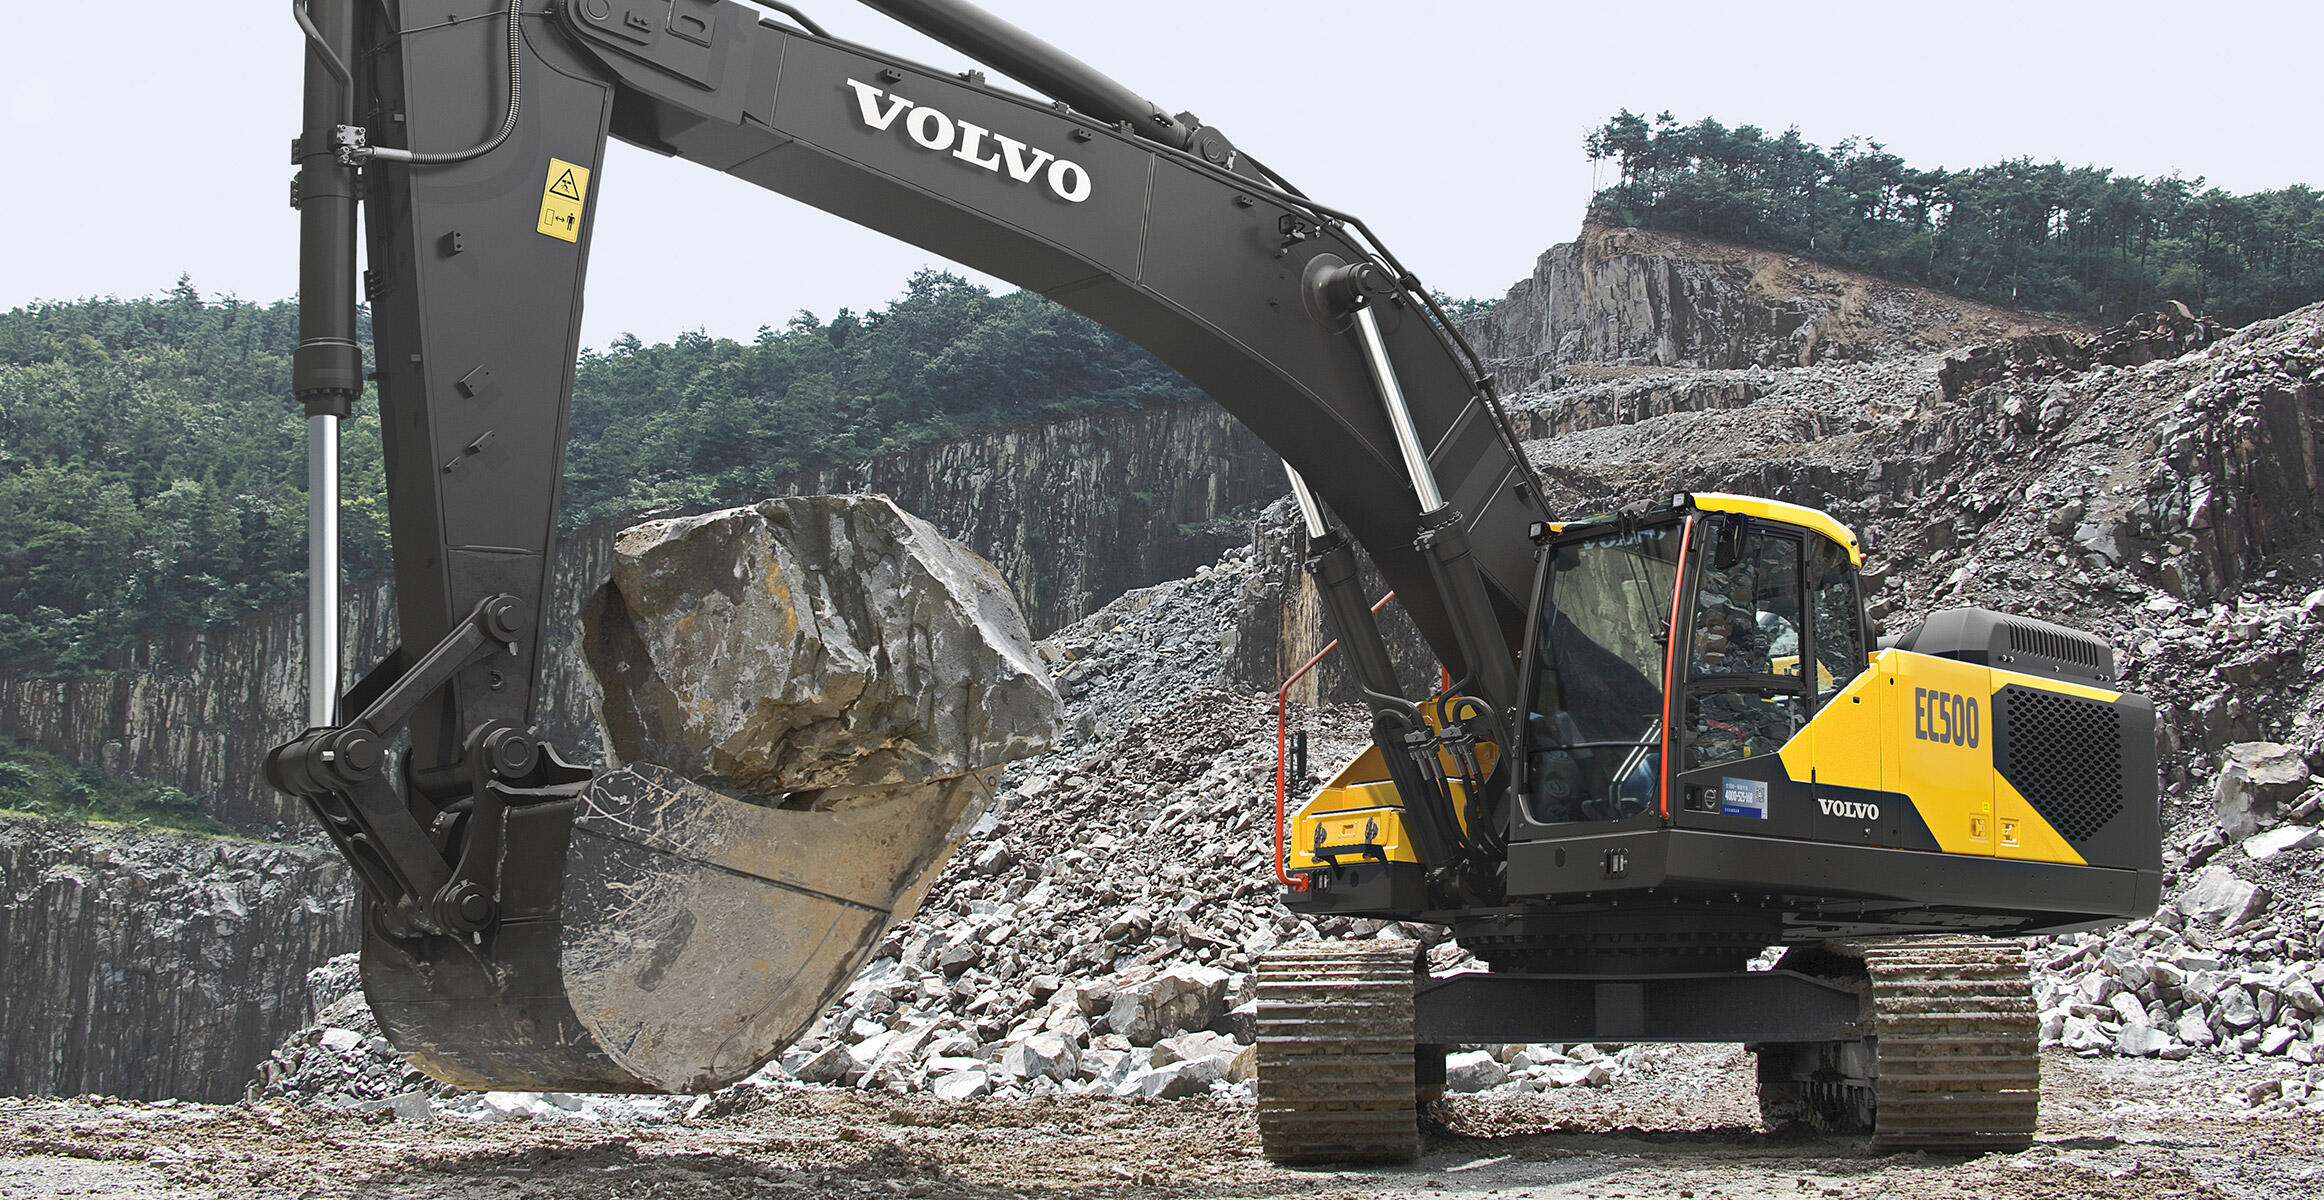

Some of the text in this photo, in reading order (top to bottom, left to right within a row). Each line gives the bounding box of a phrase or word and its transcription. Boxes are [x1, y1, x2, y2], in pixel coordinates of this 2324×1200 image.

[847, 78, 1092, 203] VOLVO
[1914, 687, 1979, 749] EC500
[1818, 798, 1880, 820] VOLVO
